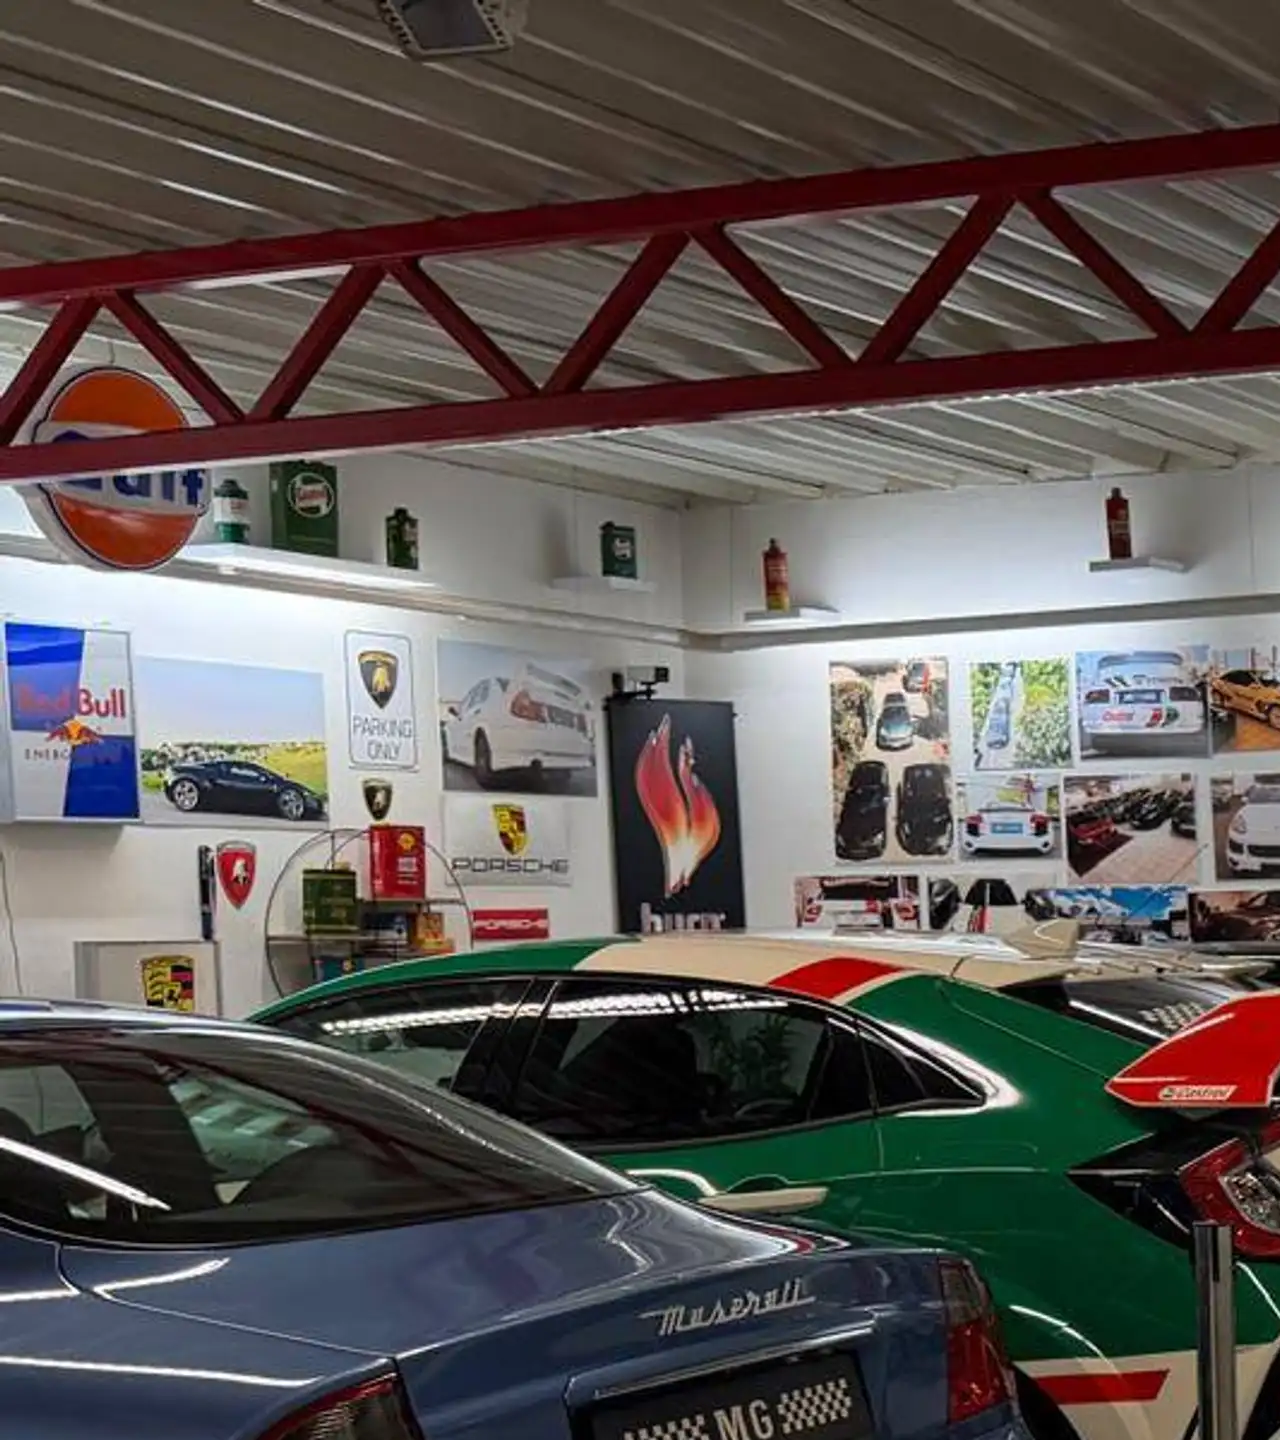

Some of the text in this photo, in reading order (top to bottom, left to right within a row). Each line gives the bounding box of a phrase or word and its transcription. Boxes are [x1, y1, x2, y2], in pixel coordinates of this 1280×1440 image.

[18, 685, 126, 718] Red Bull
[352, 714, 413, 738] PARKING
[367, 740, 402, 760] ONLY
[451, 857, 570, 873] PORSCHE
[639, 1277, 816, 1336] Maserati
